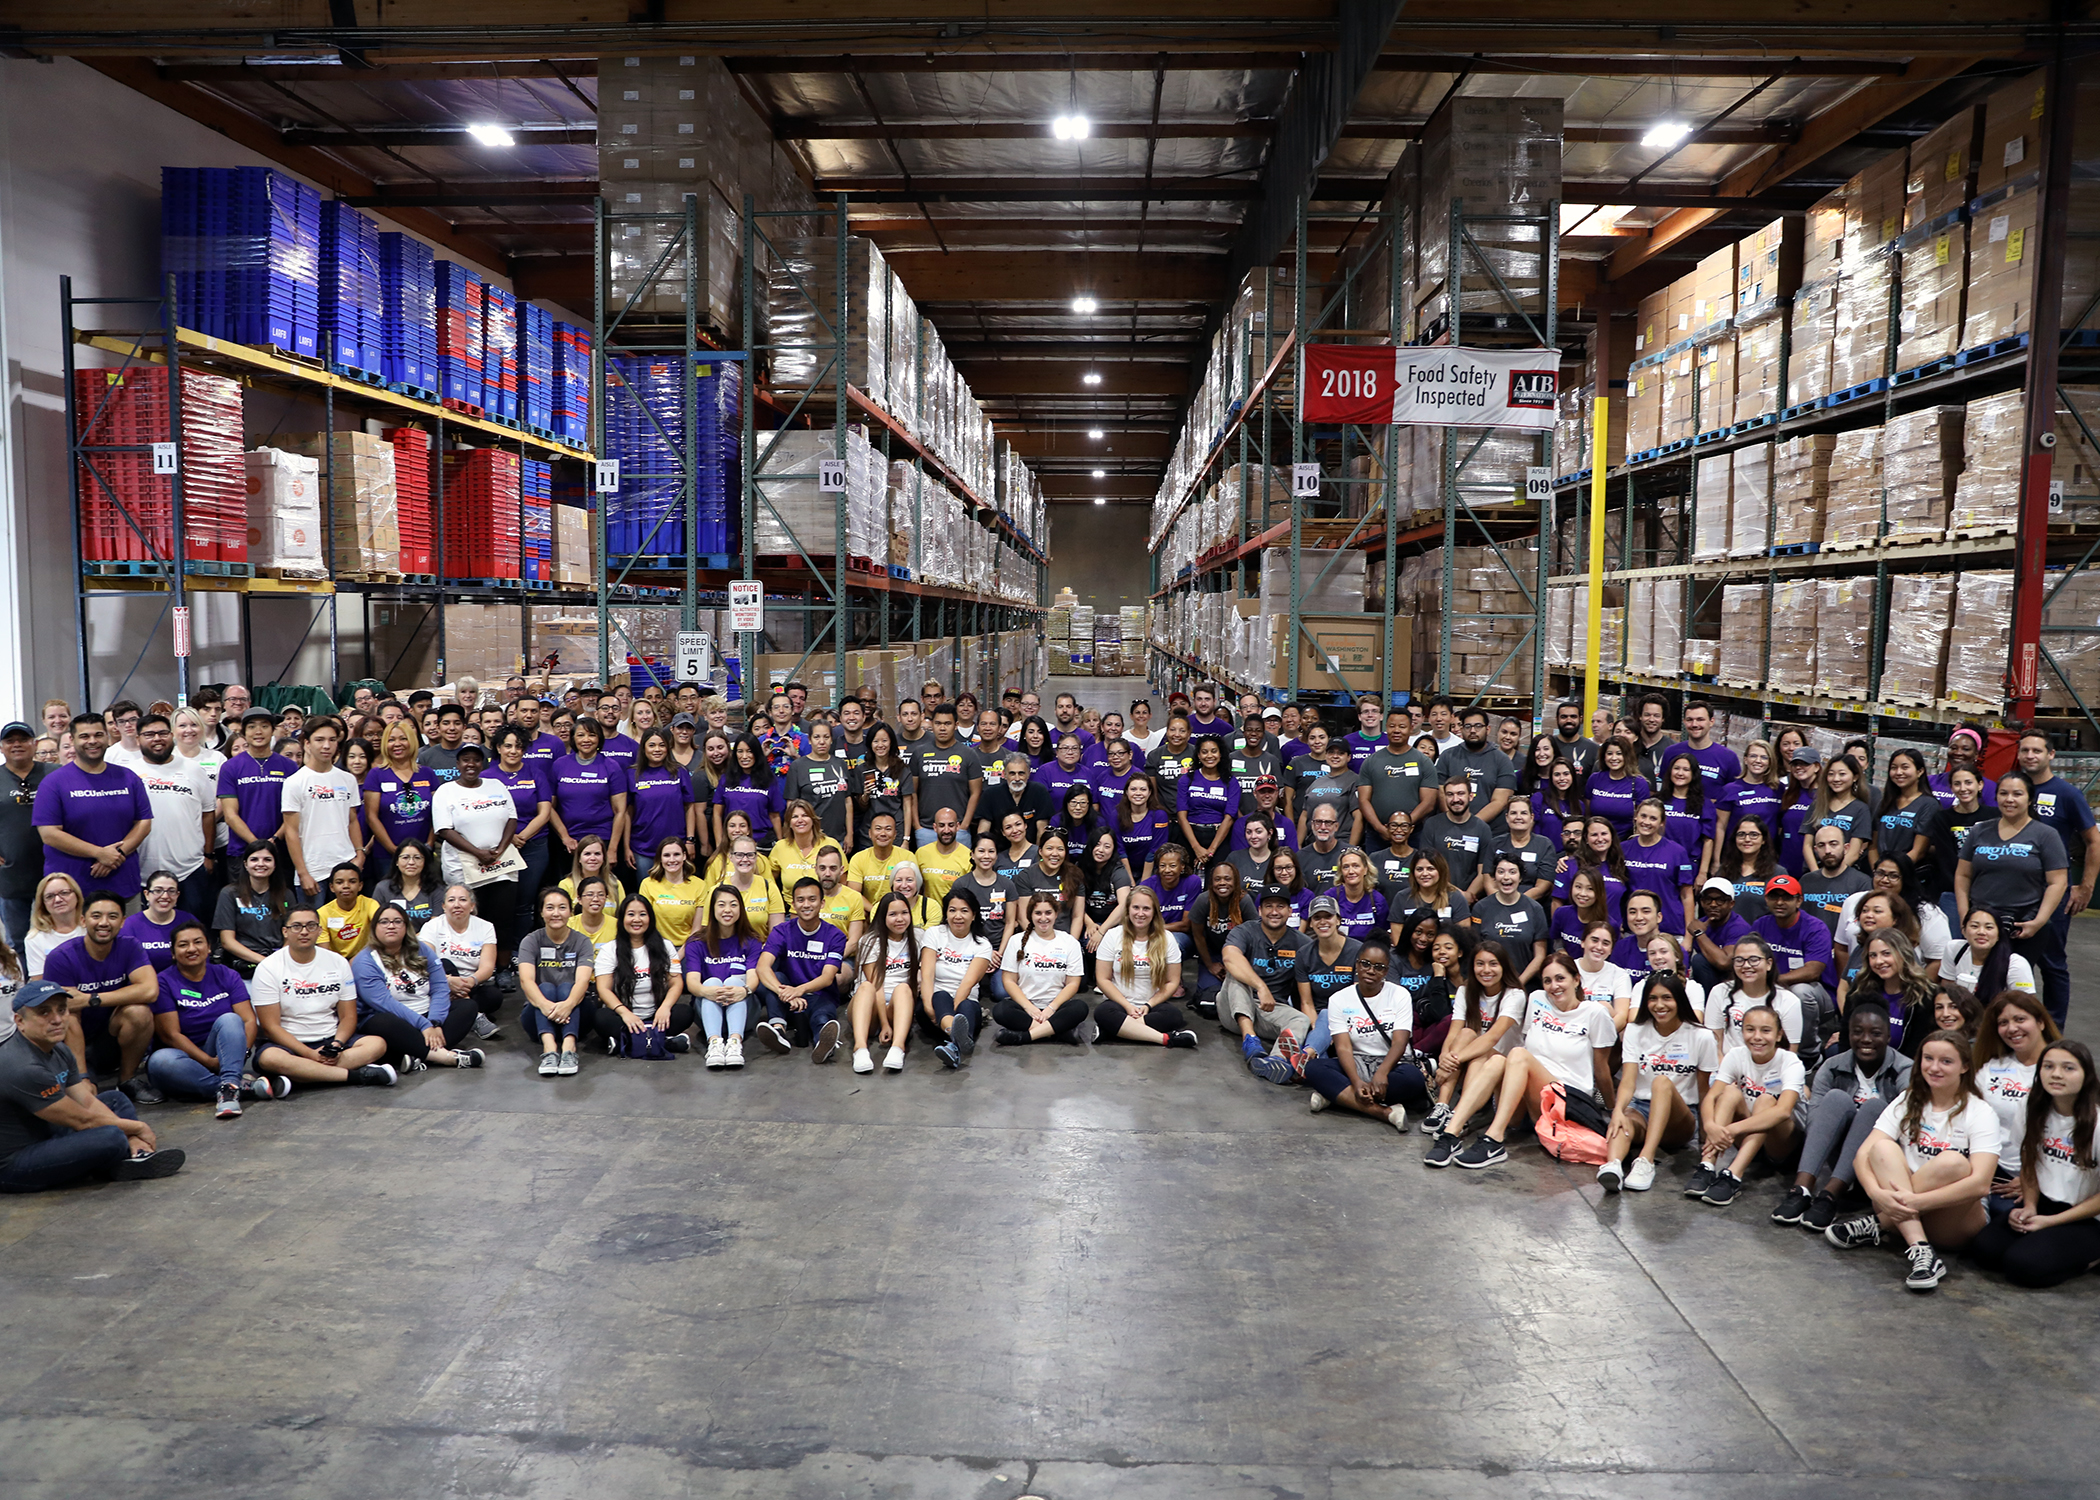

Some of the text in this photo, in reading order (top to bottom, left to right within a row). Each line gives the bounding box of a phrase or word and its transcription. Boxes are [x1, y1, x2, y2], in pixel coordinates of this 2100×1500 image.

[1321, 364, 1497, 398] 2018 Food Safety
[1514, 375, 1554, 392] AIB
[1416, 386, 1485, 408] Inspected
[157, 454, 173, 468] 11
[600, 471, 615, 485] 11
[823, 472, 843, 486] 10
[1297, 475, 1318, 490] 10
[1529, 479, 1550, 494] 09
[687, 659, 698, 676] 5
[929, 763, 961, 774] impact
[237, 776, 287, 785] NBCUnivers
[70, 788, 129, 798] NBCUniversal
[820, 783, 847, 794] impac
[1190, 792, 1227, 801] NBCUnivers
[1739, 797, 1781, 805] NBCUnivers
[292, 979, 319, 989] Disney
[295, 984, 340, 995] VOLUNTEARS
[1649, 1054, 1678, 1065] Disney
[1920, 1131, 1950, 1149] Disney
